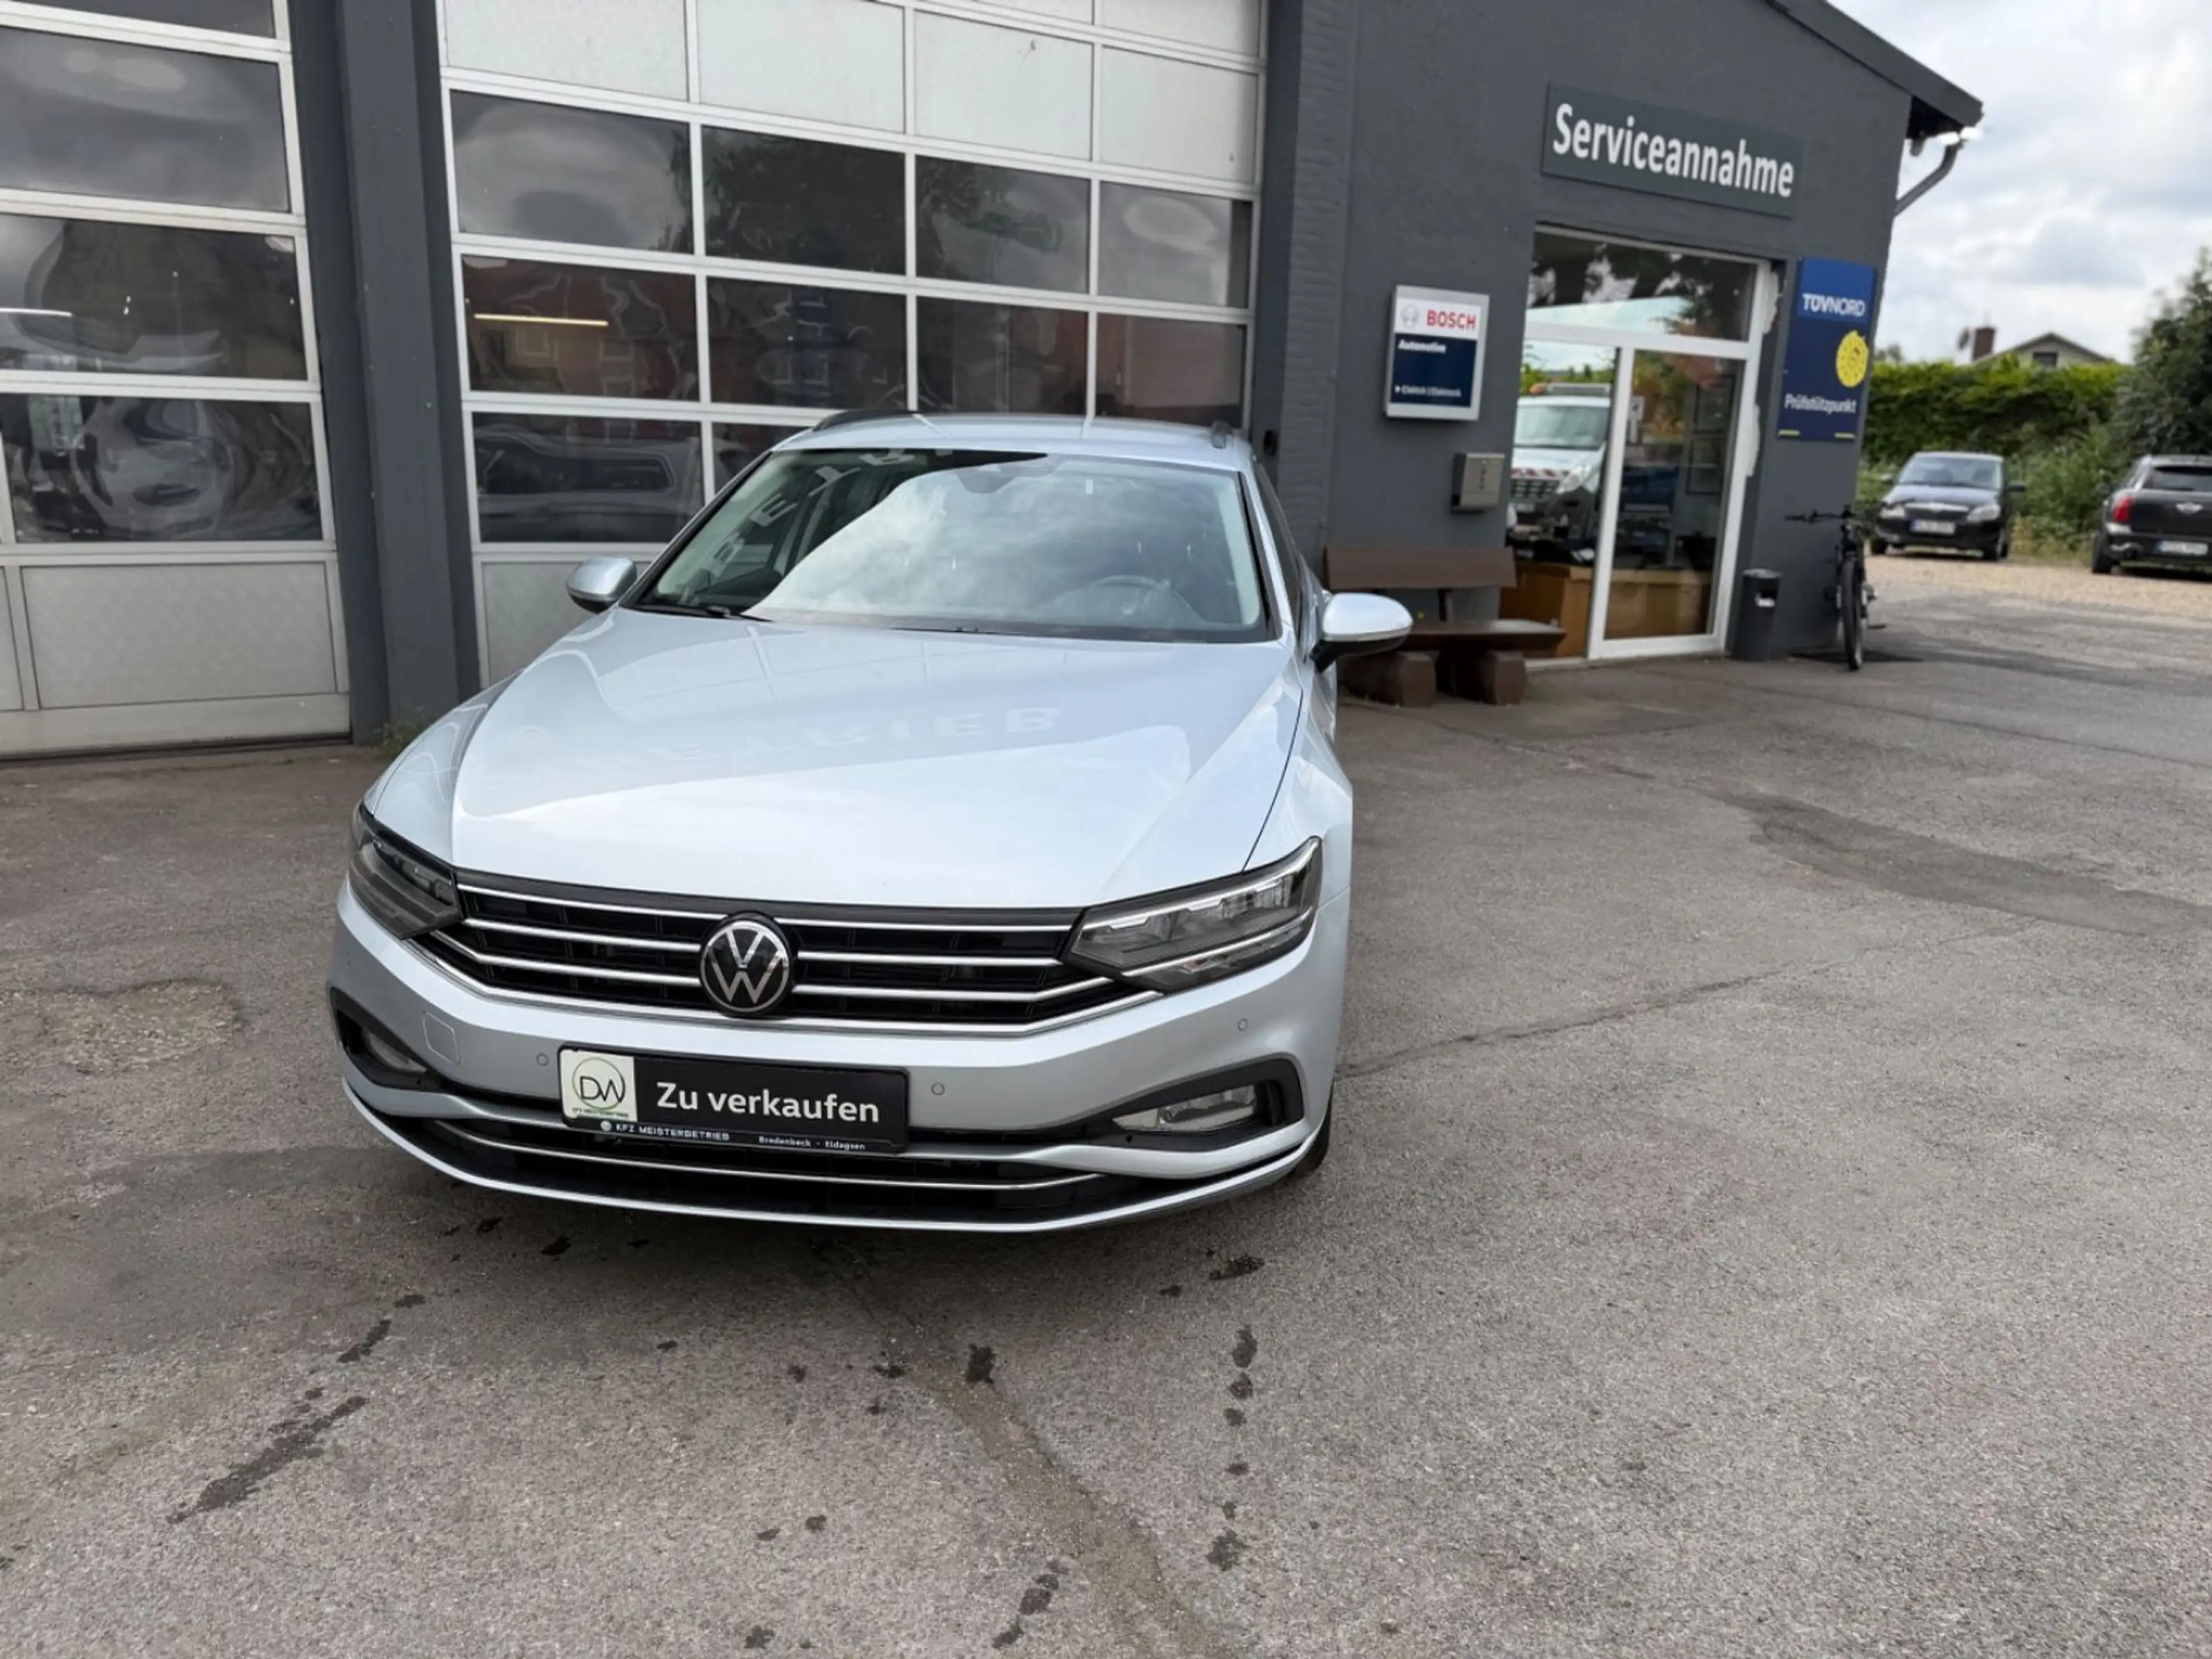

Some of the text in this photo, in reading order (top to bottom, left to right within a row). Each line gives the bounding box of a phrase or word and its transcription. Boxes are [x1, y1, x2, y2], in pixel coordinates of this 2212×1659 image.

[1553, 103, 1794, 198] Serviceannahme
[1426, 309, 1477, 330] BOSCH
[706, 922, 787, 1005] VW
[656, 1081, 880, 1123] Zu verkaufen
